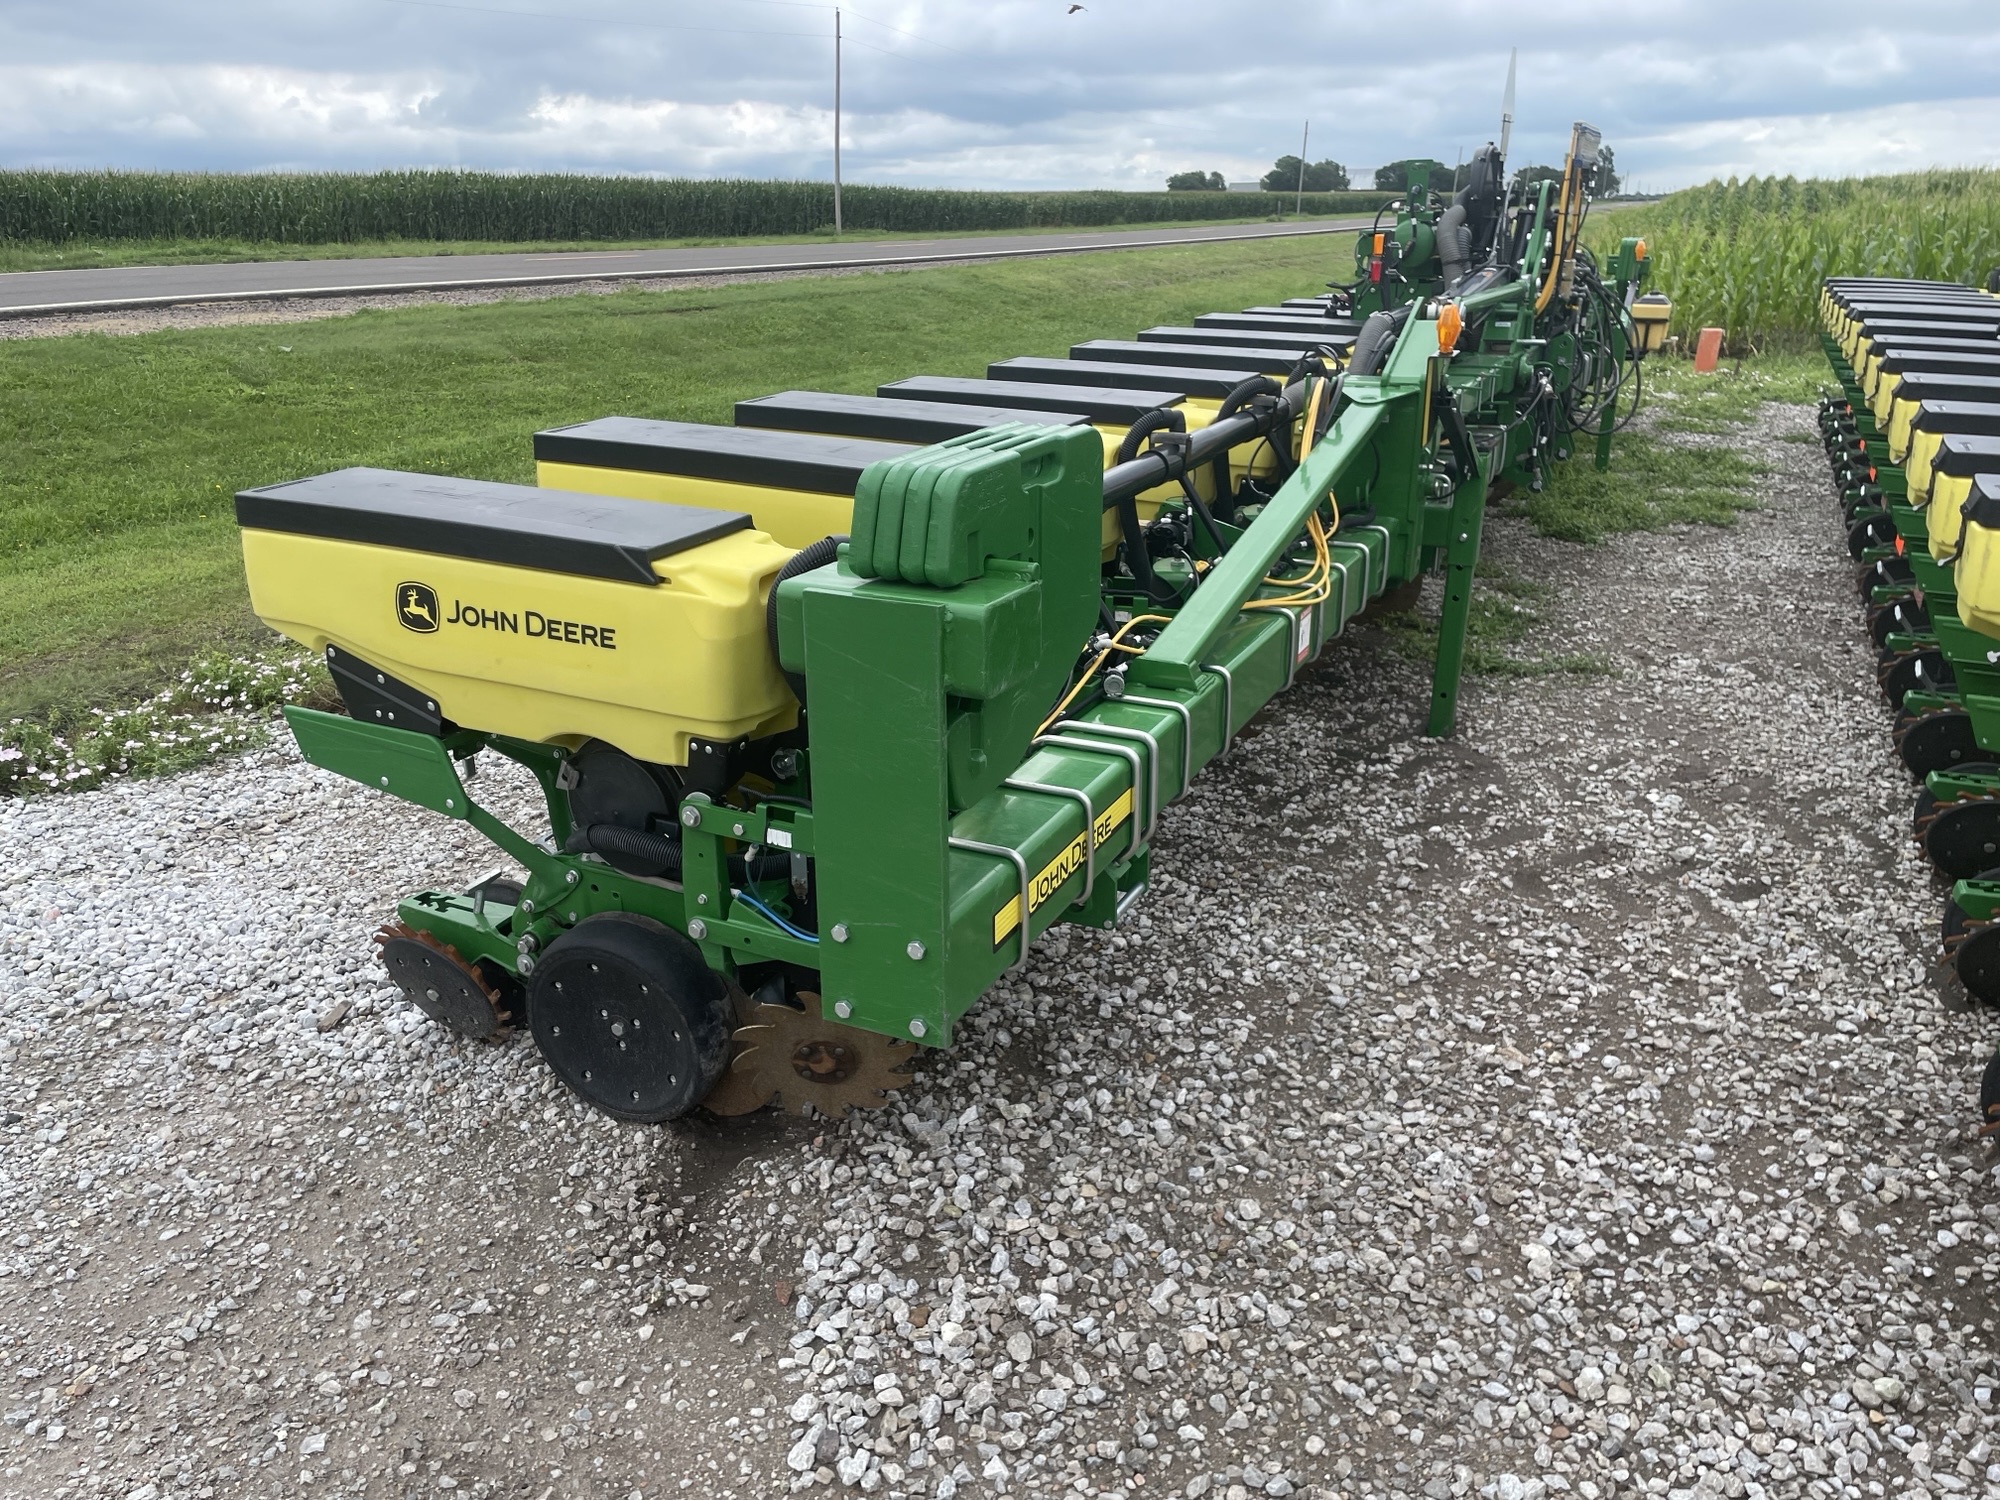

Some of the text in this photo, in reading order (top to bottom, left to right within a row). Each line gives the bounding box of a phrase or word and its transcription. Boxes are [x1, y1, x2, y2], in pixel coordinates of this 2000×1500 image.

[446, 599, 617, 650] JOHN DEERE
[1031, 856, 1069, 909] JOHN
